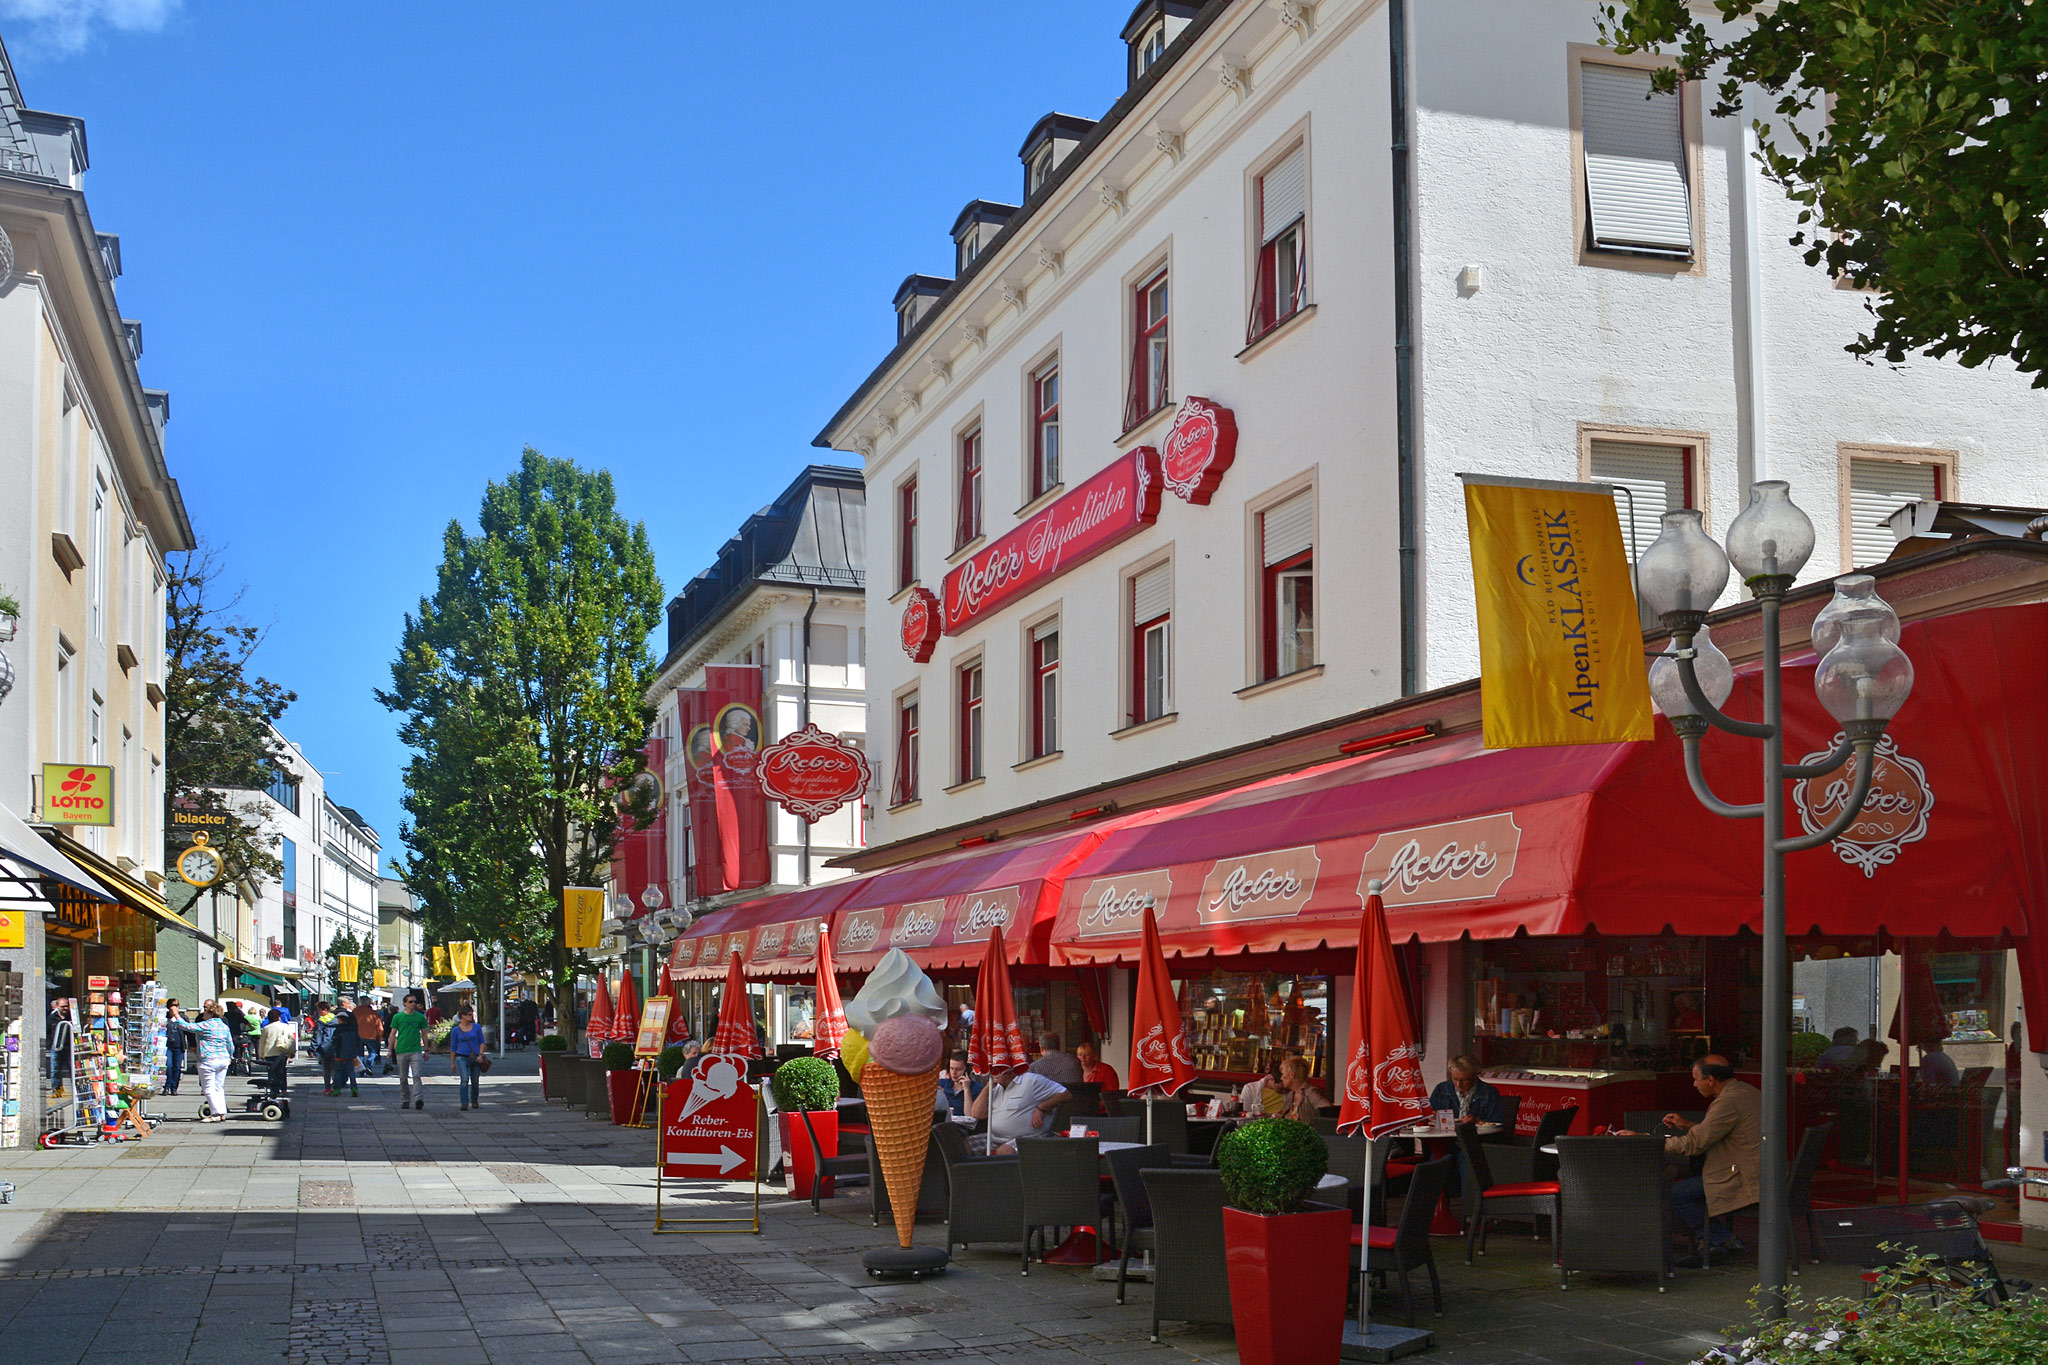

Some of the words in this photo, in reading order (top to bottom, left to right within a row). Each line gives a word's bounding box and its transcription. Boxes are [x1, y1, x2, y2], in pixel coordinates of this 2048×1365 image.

[1169, 425, 1210, 461] Reber
[951, 549, 1024, 622] Reber
[1026, 481, 1127, 573] Spezialitäten
[1532, 507, 1554, 594] REICHENHALL
[1569, 509, 1588, 573] HAUTNAH
[1543, 508, 1600, 722] AlpenKLASSIK
[1549, 600, 1557, 624] BAD
[771, 751, 852, 774] Reber
[51, 796, 104, 809] LOTTO
[63, 812, 92, 821] Bayern
[1379, 839, 1497, 895] Reber
[1208, 865, 1302, 912] Reber
[841, 917, 877, 946] Reber
[896, 909, 936, 943] Reber
[666, 1126, 754, 1139] Konditoren-Eis
[691, 1115, 729, 1126] Reber-
